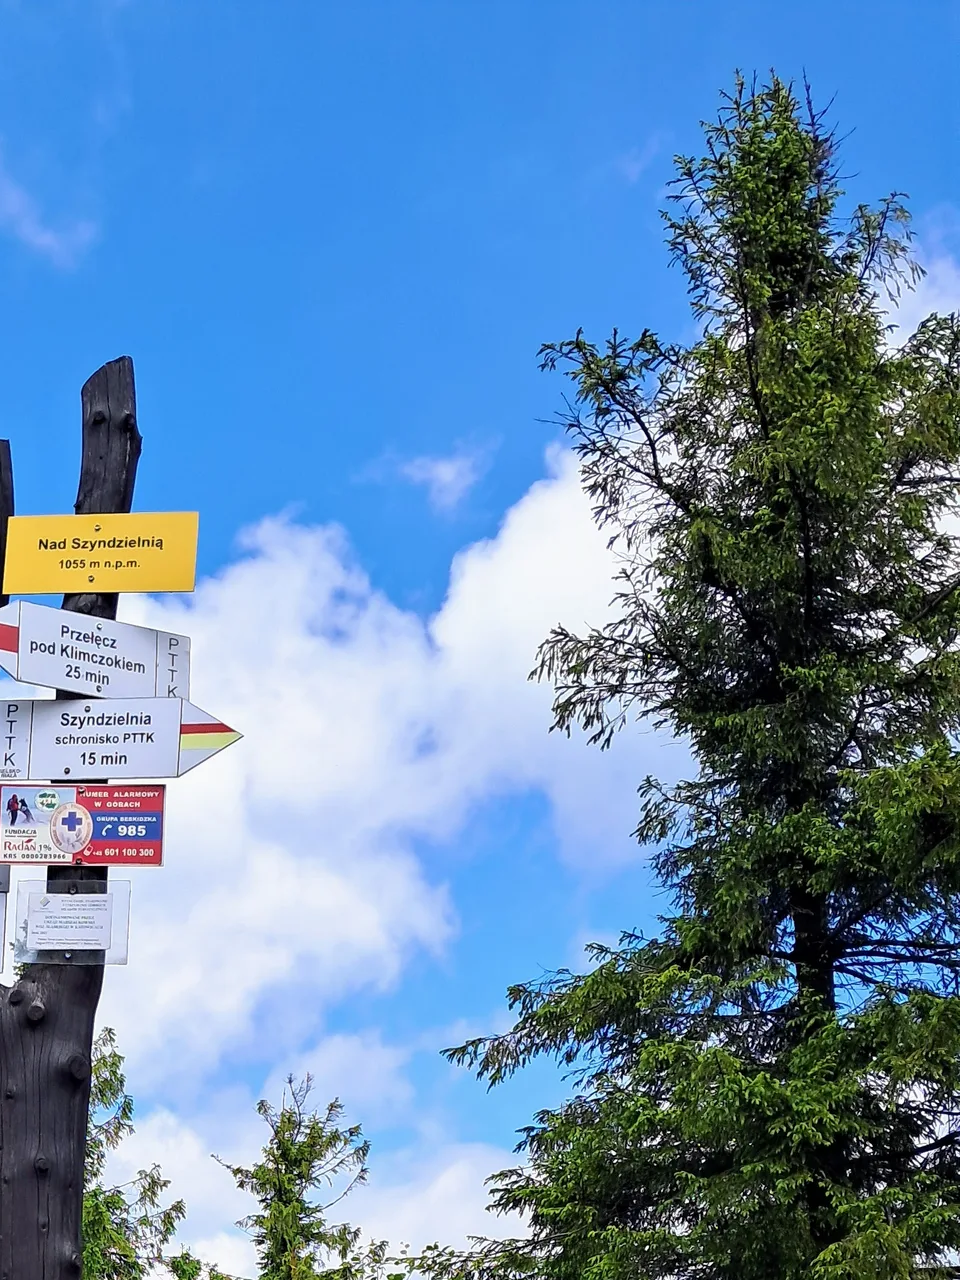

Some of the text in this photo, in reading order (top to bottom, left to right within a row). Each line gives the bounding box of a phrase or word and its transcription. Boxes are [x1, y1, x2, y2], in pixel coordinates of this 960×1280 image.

[38, 536, 164, 552] Nad Szyndzielnią
[58, 559, 141, 571] 1055 m n.p.m.
[60, 624, 118, 650] Przełęcz
[30, 640, 146, 675] pod Klimczokiem
[65, 664, 110, 686] 25 min
[166, 637, 180, 698] PTTK
[60, 711, 152, 730] Szyndzielnia
[3, 703, 19, 767] PTTK
[54, 732, 155, 745] schronisko PTTK
[80, 751, 128, 766] 15 min
[117, 825, 147, 837] 985
[104, 848, 119, 857] 601
[122, 848, 137, 857] 100
[139, 848, 154, 857] 300
